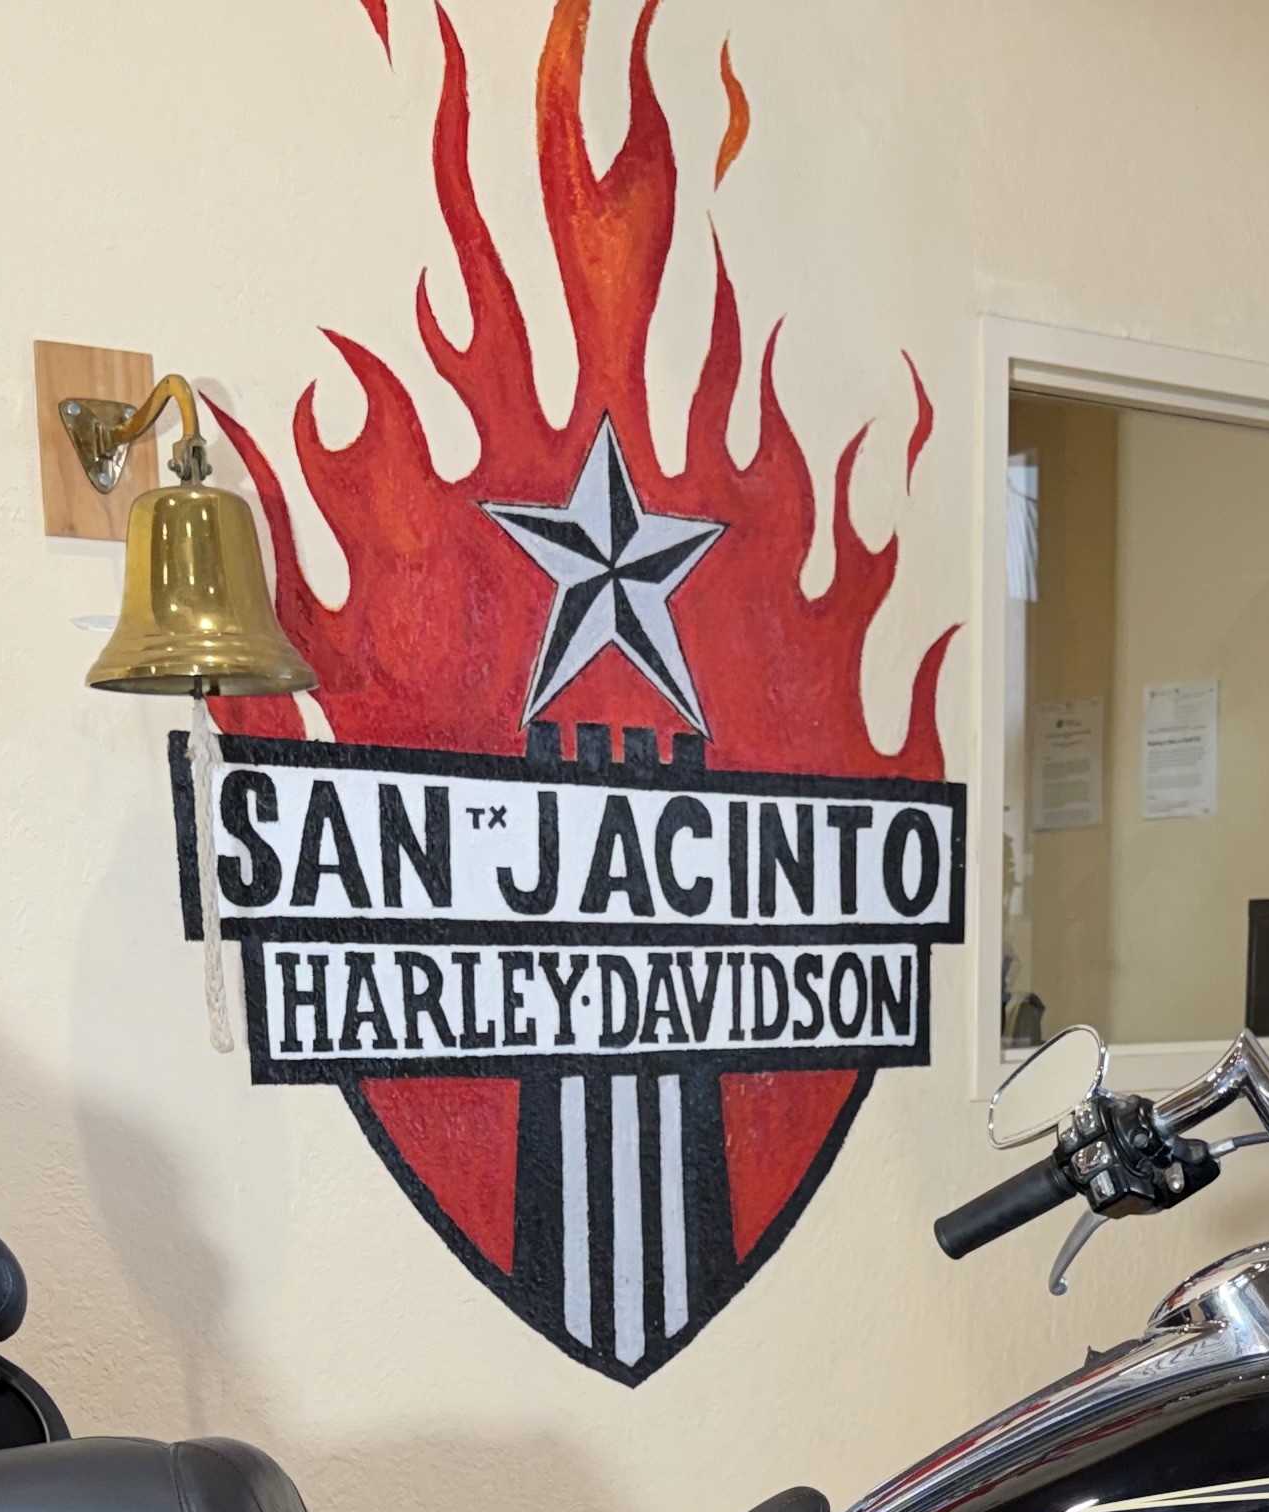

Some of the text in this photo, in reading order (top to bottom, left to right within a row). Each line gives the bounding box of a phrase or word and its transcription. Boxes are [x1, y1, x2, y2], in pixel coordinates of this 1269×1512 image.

[217, 769, 939, 918] SAN JACINTO
[466, 805, 507, 829] TX
